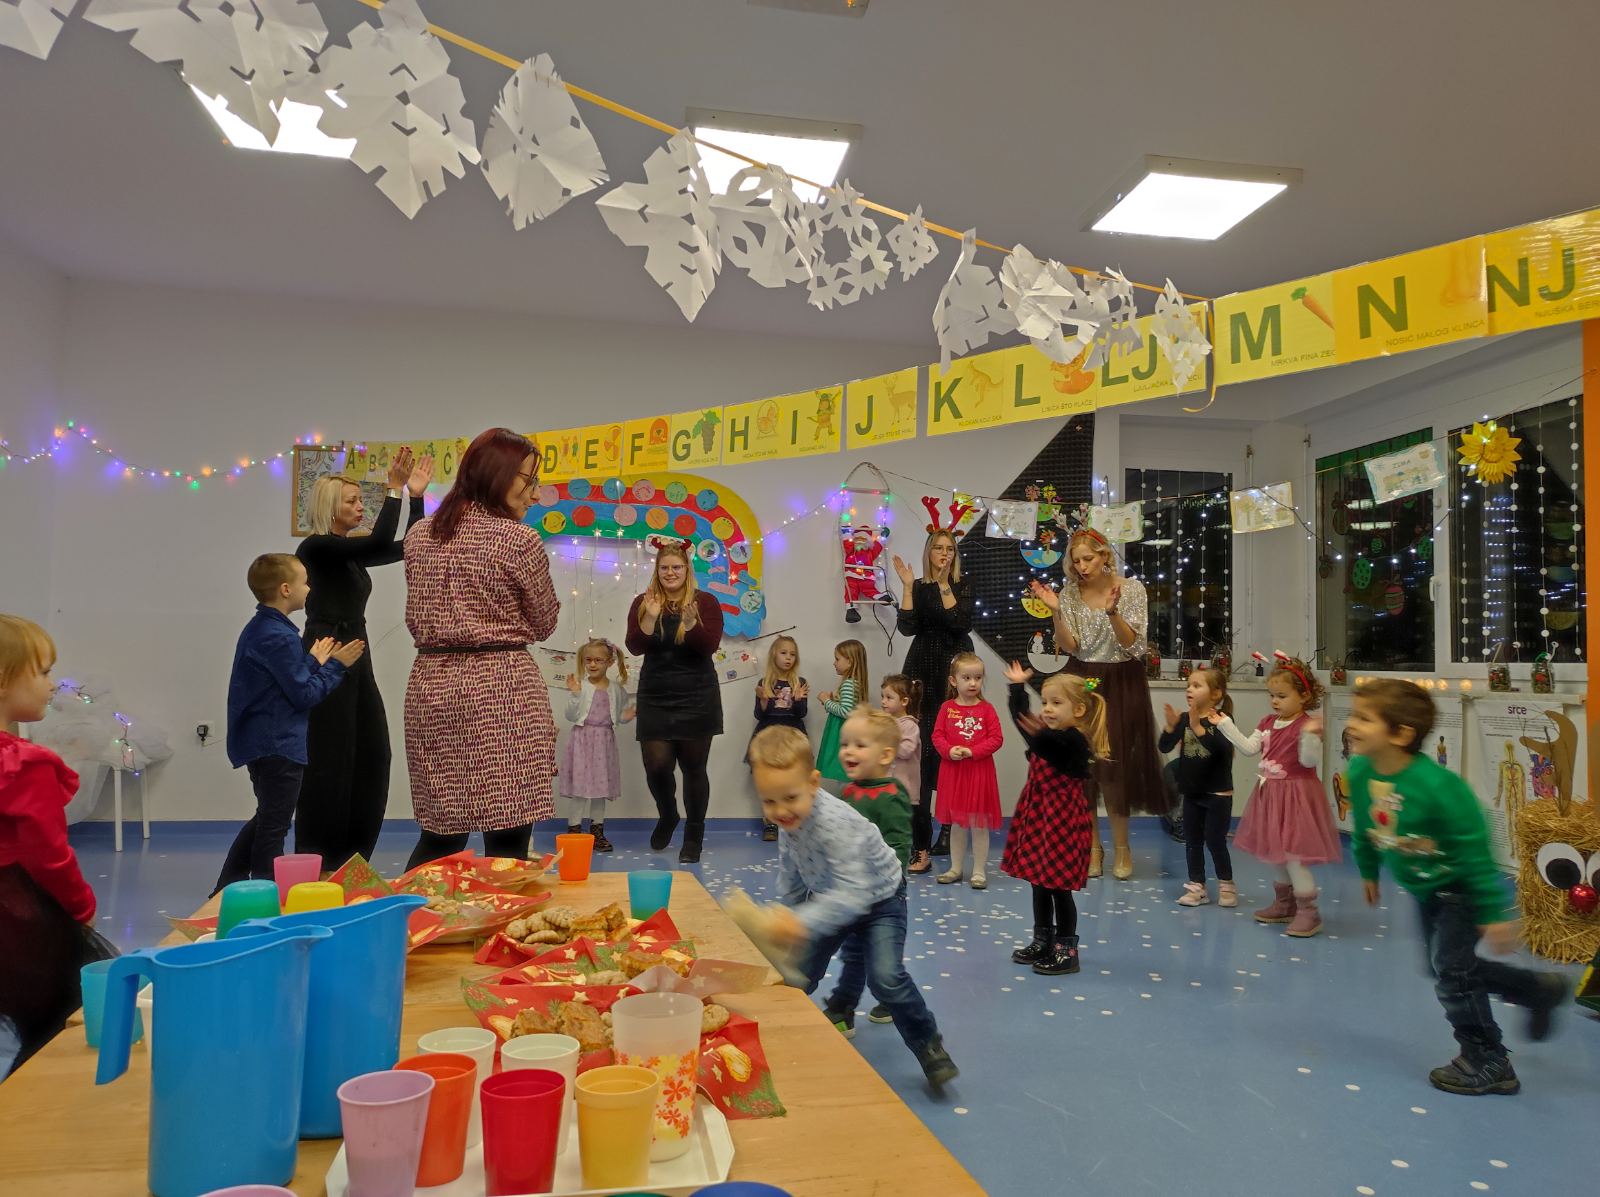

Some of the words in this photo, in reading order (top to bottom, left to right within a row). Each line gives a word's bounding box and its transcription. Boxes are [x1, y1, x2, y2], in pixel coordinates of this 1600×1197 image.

[1486, 247, 1576, 313] NJ
[1356, 275, 1409, 340] N
[1229, 303, 1282, 365] M
[1101, 334, 1158, 388] LJ
[933, 376, 963, 423] K
[1014, 363, 1041, 408] L
[729, 415, 750, 453] H
[790, 409, 799, 445] I
[854, 394, 874, 436] J
[345, 448, 356, 469] A
[369, 454, 377, 472] B
[584, 439, 599, 469] E
[630, 433, 645, 465] F
[671, 429, 691, 462] G
[1507, 705, 1527, 715] srce
